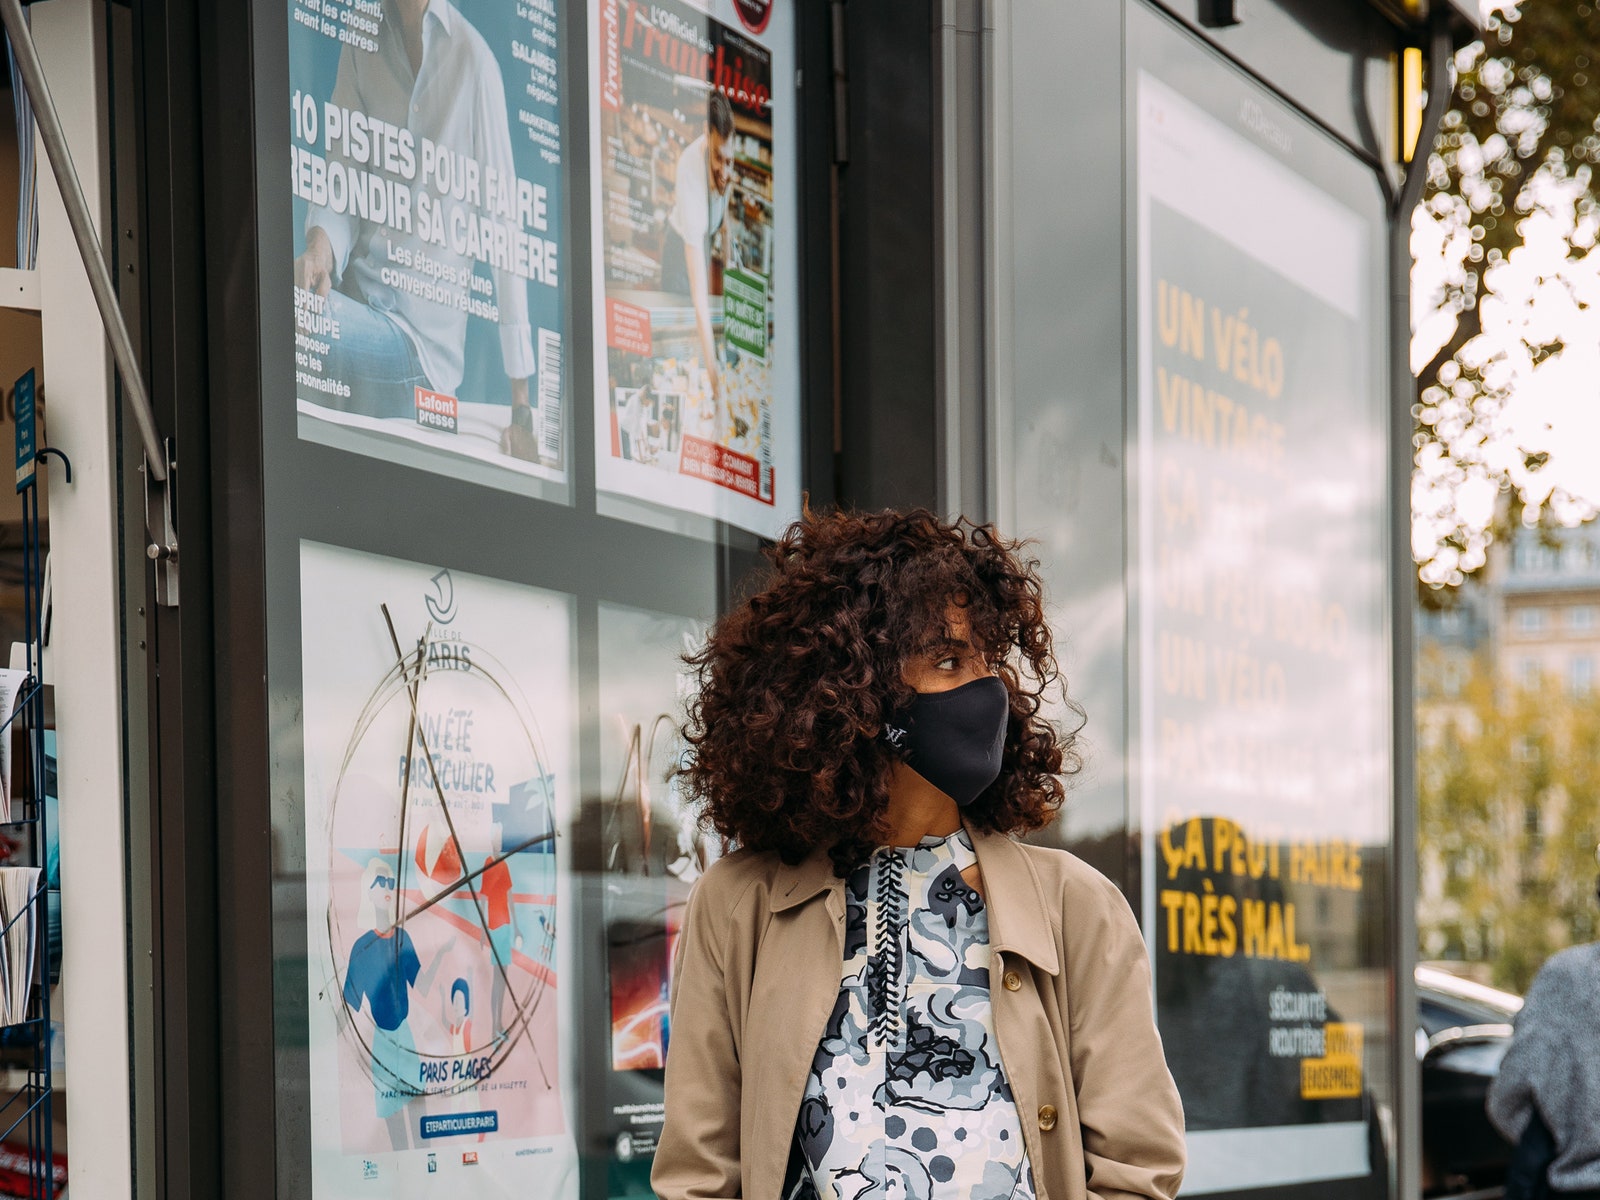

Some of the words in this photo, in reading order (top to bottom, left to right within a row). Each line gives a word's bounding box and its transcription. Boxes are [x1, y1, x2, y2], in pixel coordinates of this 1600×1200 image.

[294, 7, 319, 31] avant
[321, 18, 337, 38] les
[321, 0, 338, 20] les
[340, 9, 379, 36] choses
[511, 39, 557, 77] SALAIRES
[293, 89, 318, 145] 10
[324, 100, 416, 181] PISTES
[421, 136, 481, 208] POUR
[485, 164, 548, 232] FAIRE
[417, 191, 447, 247] SA
[387, 239, 413, 267] Les
[414, 249, 457, 283] étapes
[460, 267, 493, 298] d'une
[380, 265, 451, 307] conversion
[454, 290, 499, 322] réussie
[1157, 278, 1205, 362] UN
[1211, 306, 1285, 400] VÉLO
[309, 353, 323, 372] les
[418, 390, 455, 416] Lafont
[418, 407, 455, 429] presse
[416, 639, 471, 673] PARIS
[1160, 629, 1207, 702] UN
[1213, 638, 1287, 712] VÉLO
[416, 711, 442, 749] UN
[444, 706, 474, 753] ÉTÉ
[398, 752, 497, 794] PARTICULIER
[1160, 806, 1207, 881] ÇA
[1211, 816, 1280, 881] PEUT
[1288, 834, 1363, 892] FAIRE
[1160, 877, 1237, 958] TRÈS
[1241, 897, 1311, 964] MAL.
[1268, 984, 1327, 1021] SÉCURITÉ
[419, 1060, 448, 1084] PARIS
[451, 1056, 493, 1082] PLAGES
